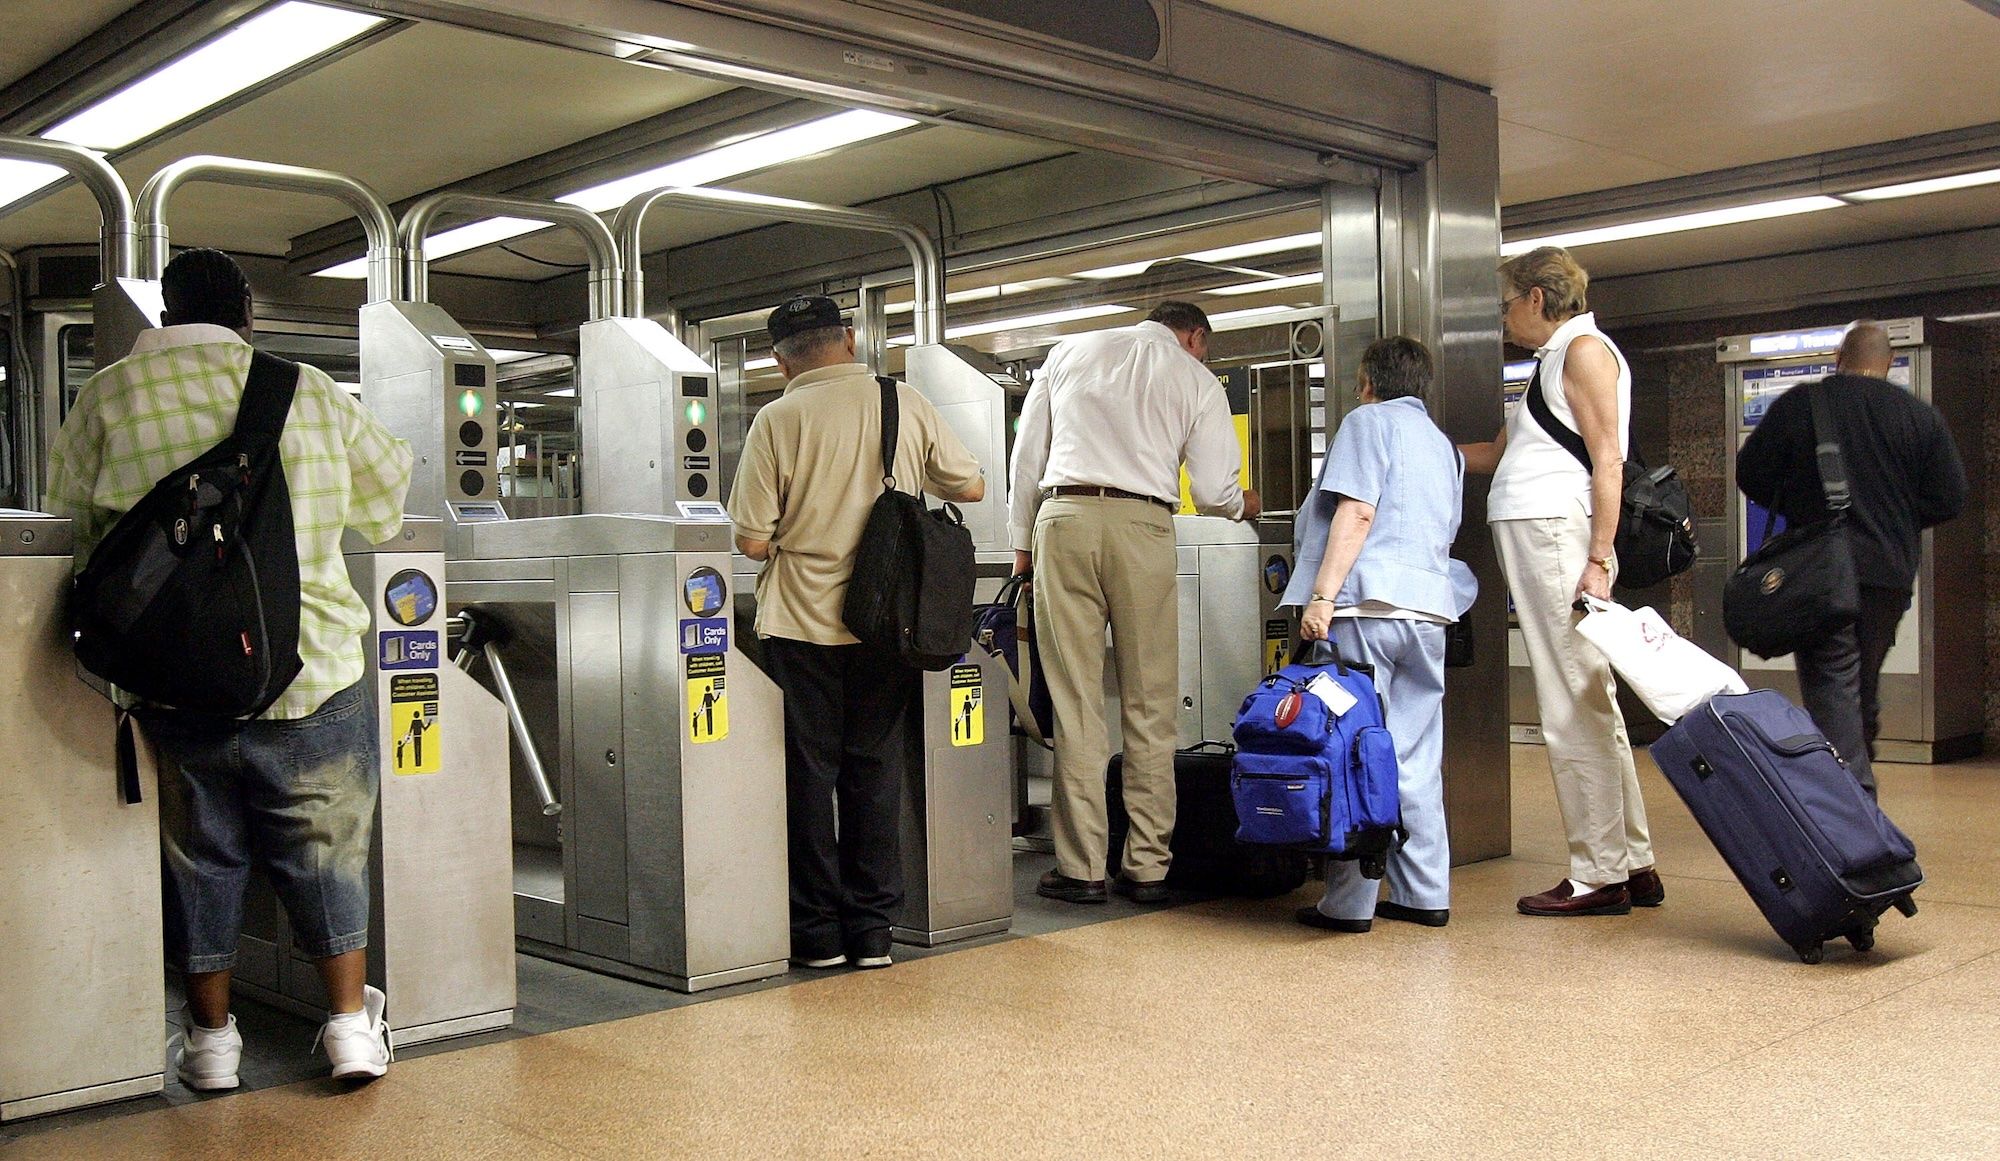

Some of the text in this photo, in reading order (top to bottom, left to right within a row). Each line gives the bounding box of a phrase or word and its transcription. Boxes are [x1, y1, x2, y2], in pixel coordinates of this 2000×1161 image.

[704, 627, 726, 635] Cards
[409, 641, 436, 650] Cards
[704, 636, 721, 646] Only
[409, 650, 431, 661] Only
